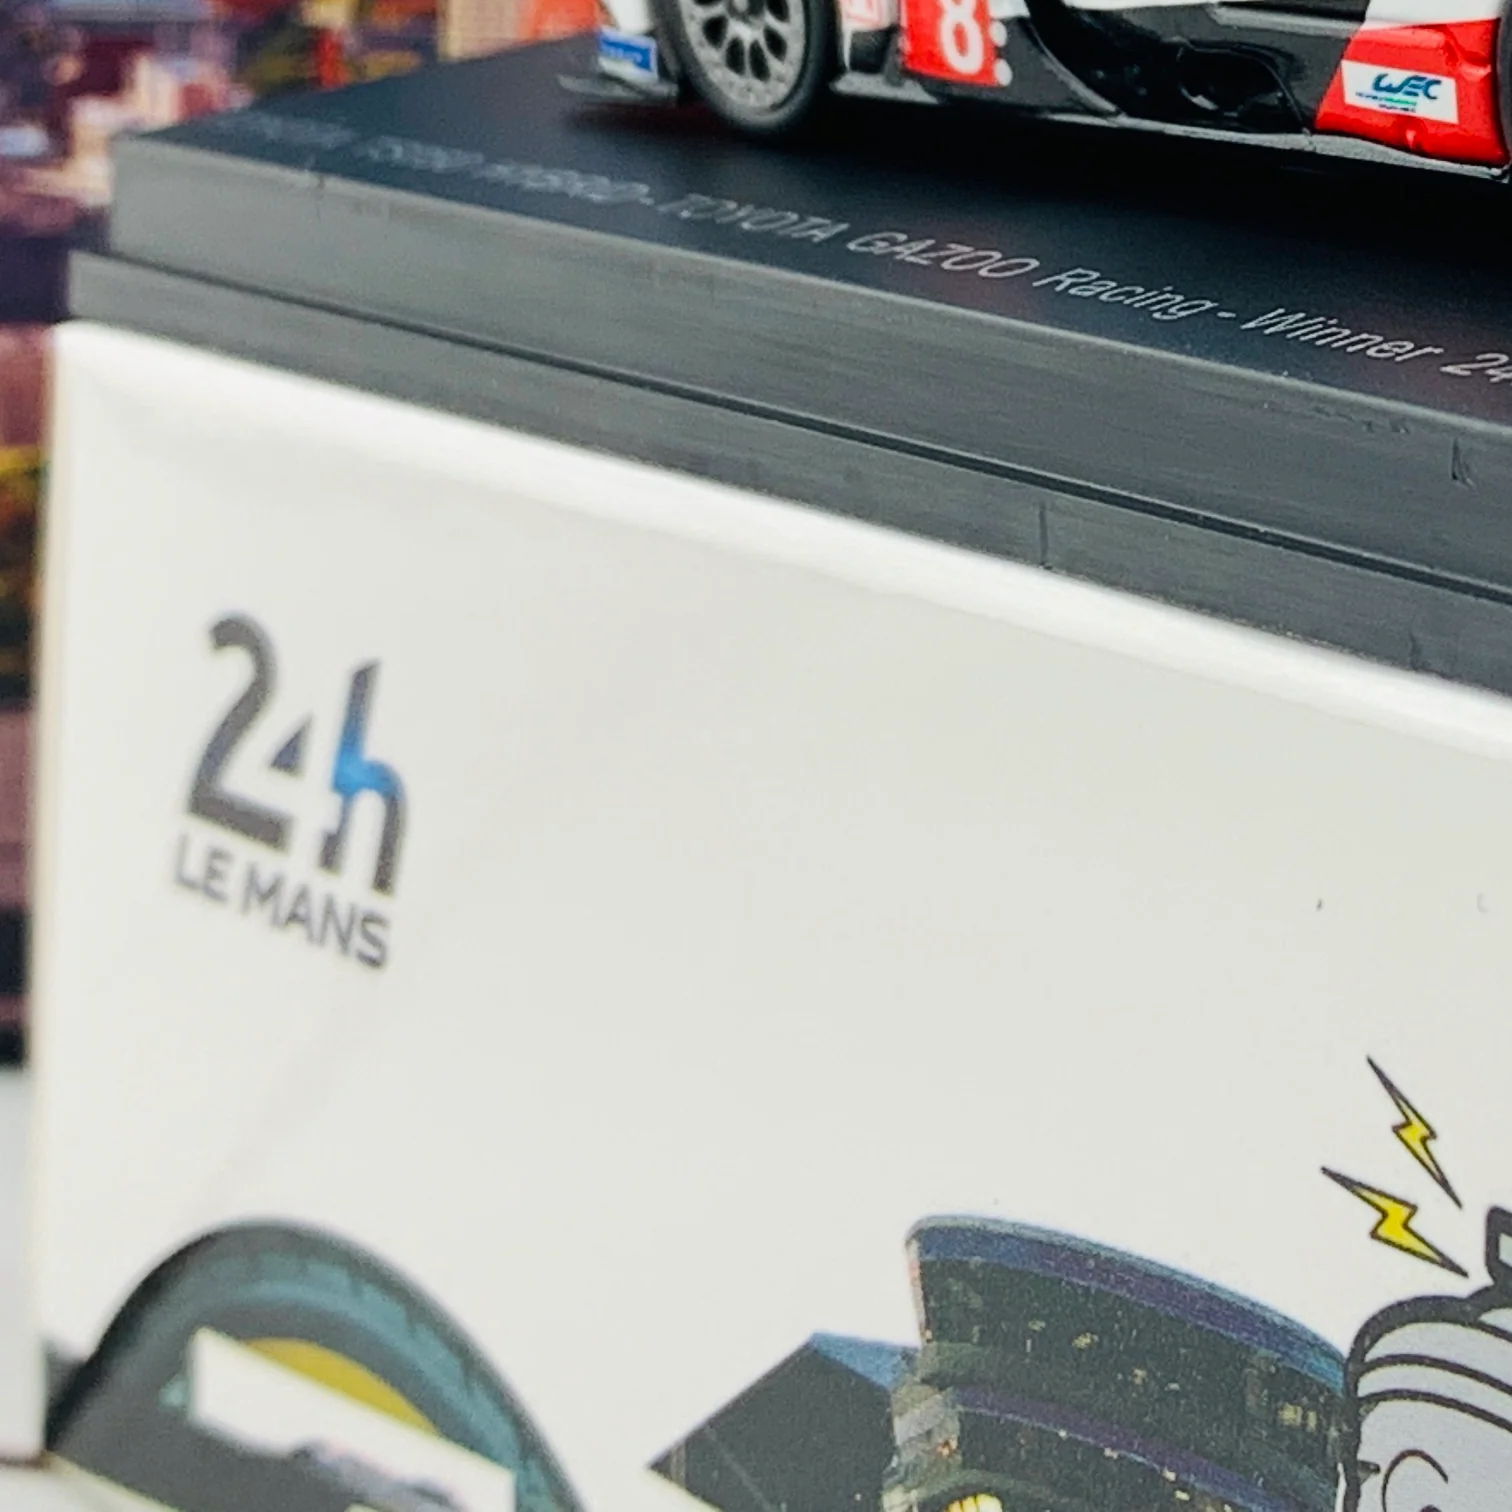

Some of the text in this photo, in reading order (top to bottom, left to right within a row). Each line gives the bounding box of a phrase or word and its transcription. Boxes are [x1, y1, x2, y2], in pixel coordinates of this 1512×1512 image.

[1372, 73, 1443, 101] WEC
[846, 231, 1041, 280] GAZOO
[1032, 267, 1220, 321] Racing
[1240, 307, 1444, 363] Winner
[172, 832, 391, 972] LE MANS
